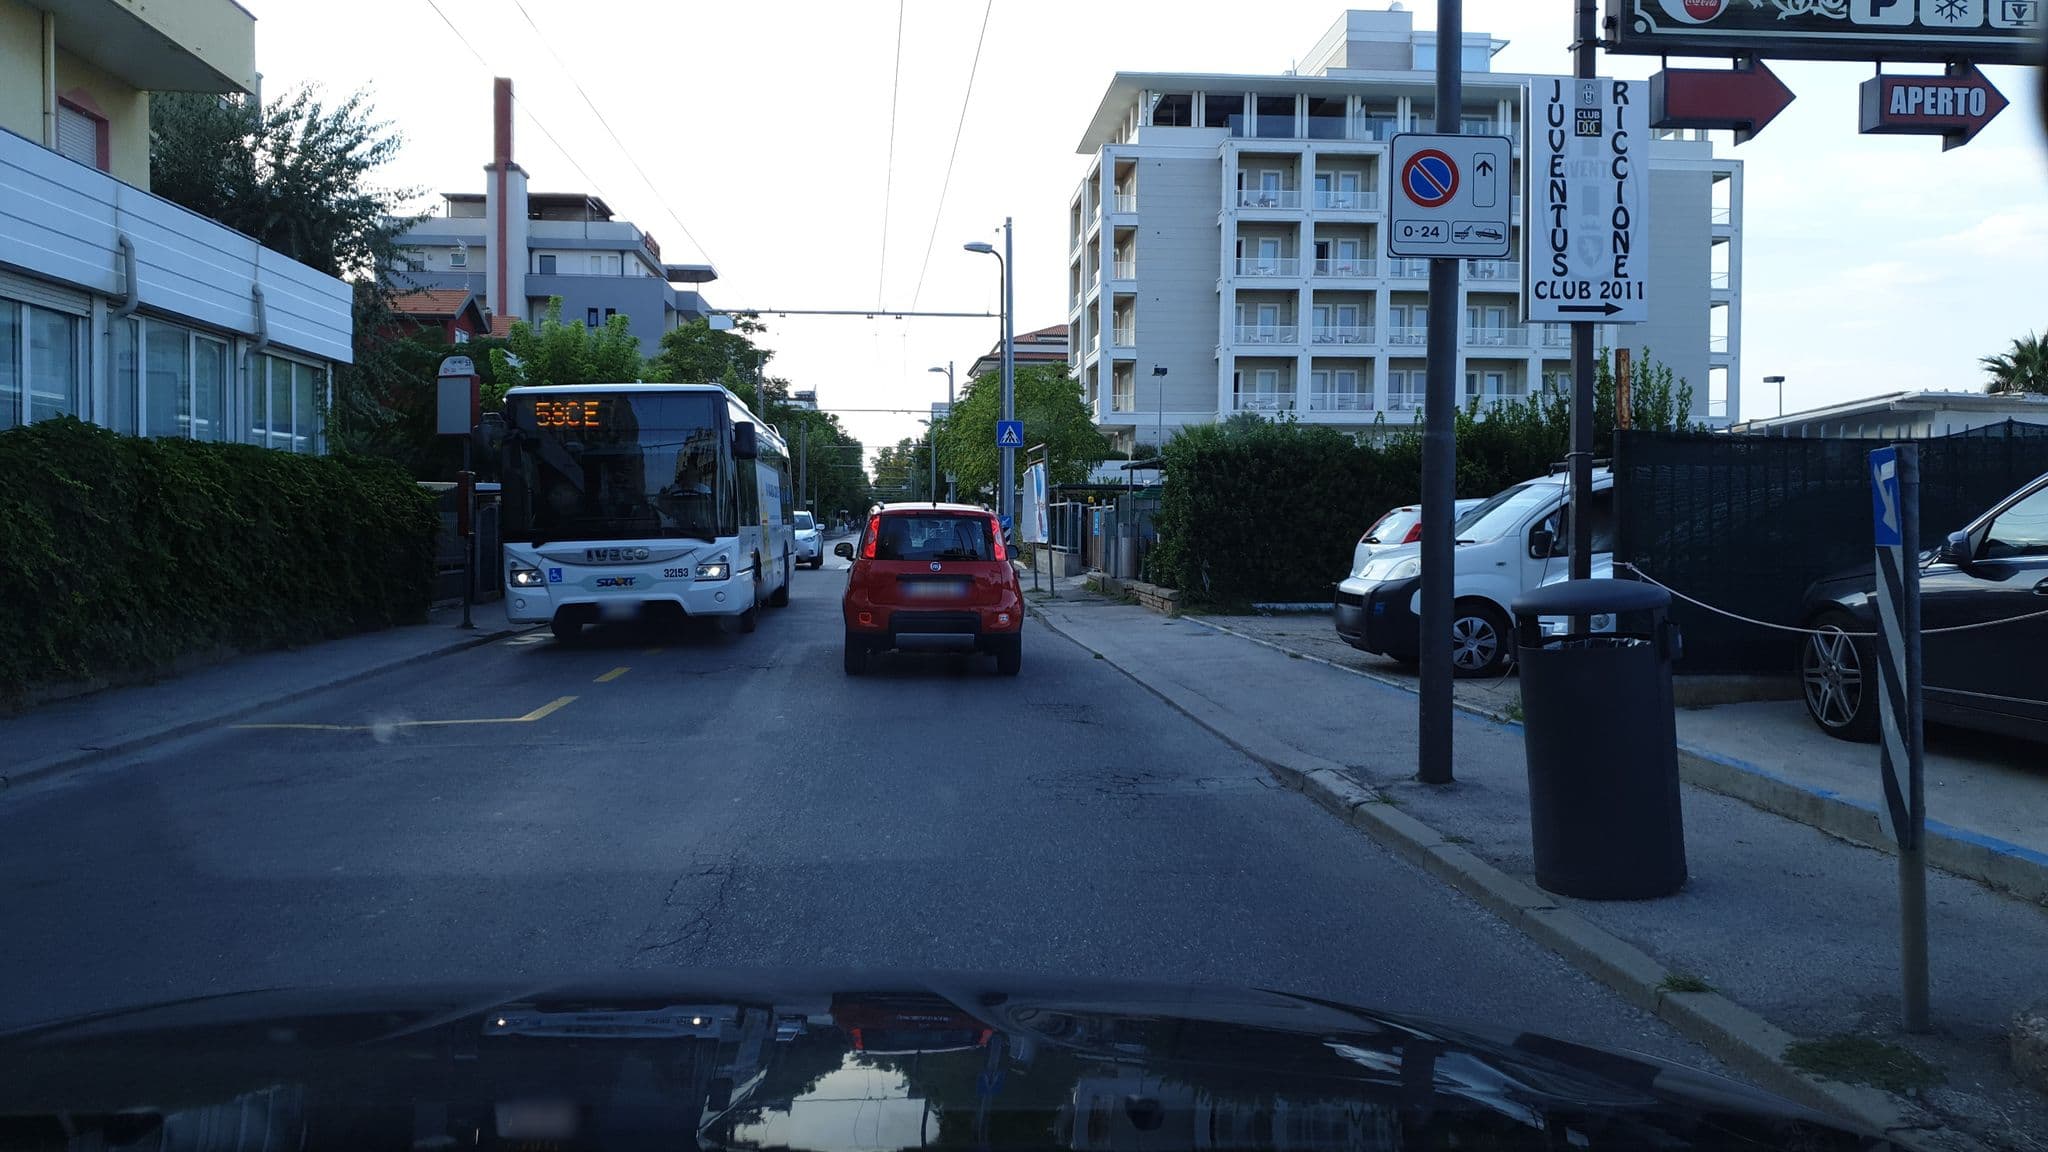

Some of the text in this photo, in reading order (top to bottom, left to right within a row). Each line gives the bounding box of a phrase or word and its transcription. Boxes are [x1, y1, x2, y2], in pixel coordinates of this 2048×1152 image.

[1889, 86, 1986, 117] APERTO
[1577, 110, 1601, 120] CLUB
[1547, 79, 1569, 278] JUVENTUS
[1611, 80, 1631, 279] RICCIONE
[1403, 225, 1440, 238] 0-24
[1534, 280, 1644, 300] CLUB 2011
[585, 547, 650, 561] IVECO
[663, 567, 690, 578] 32153
